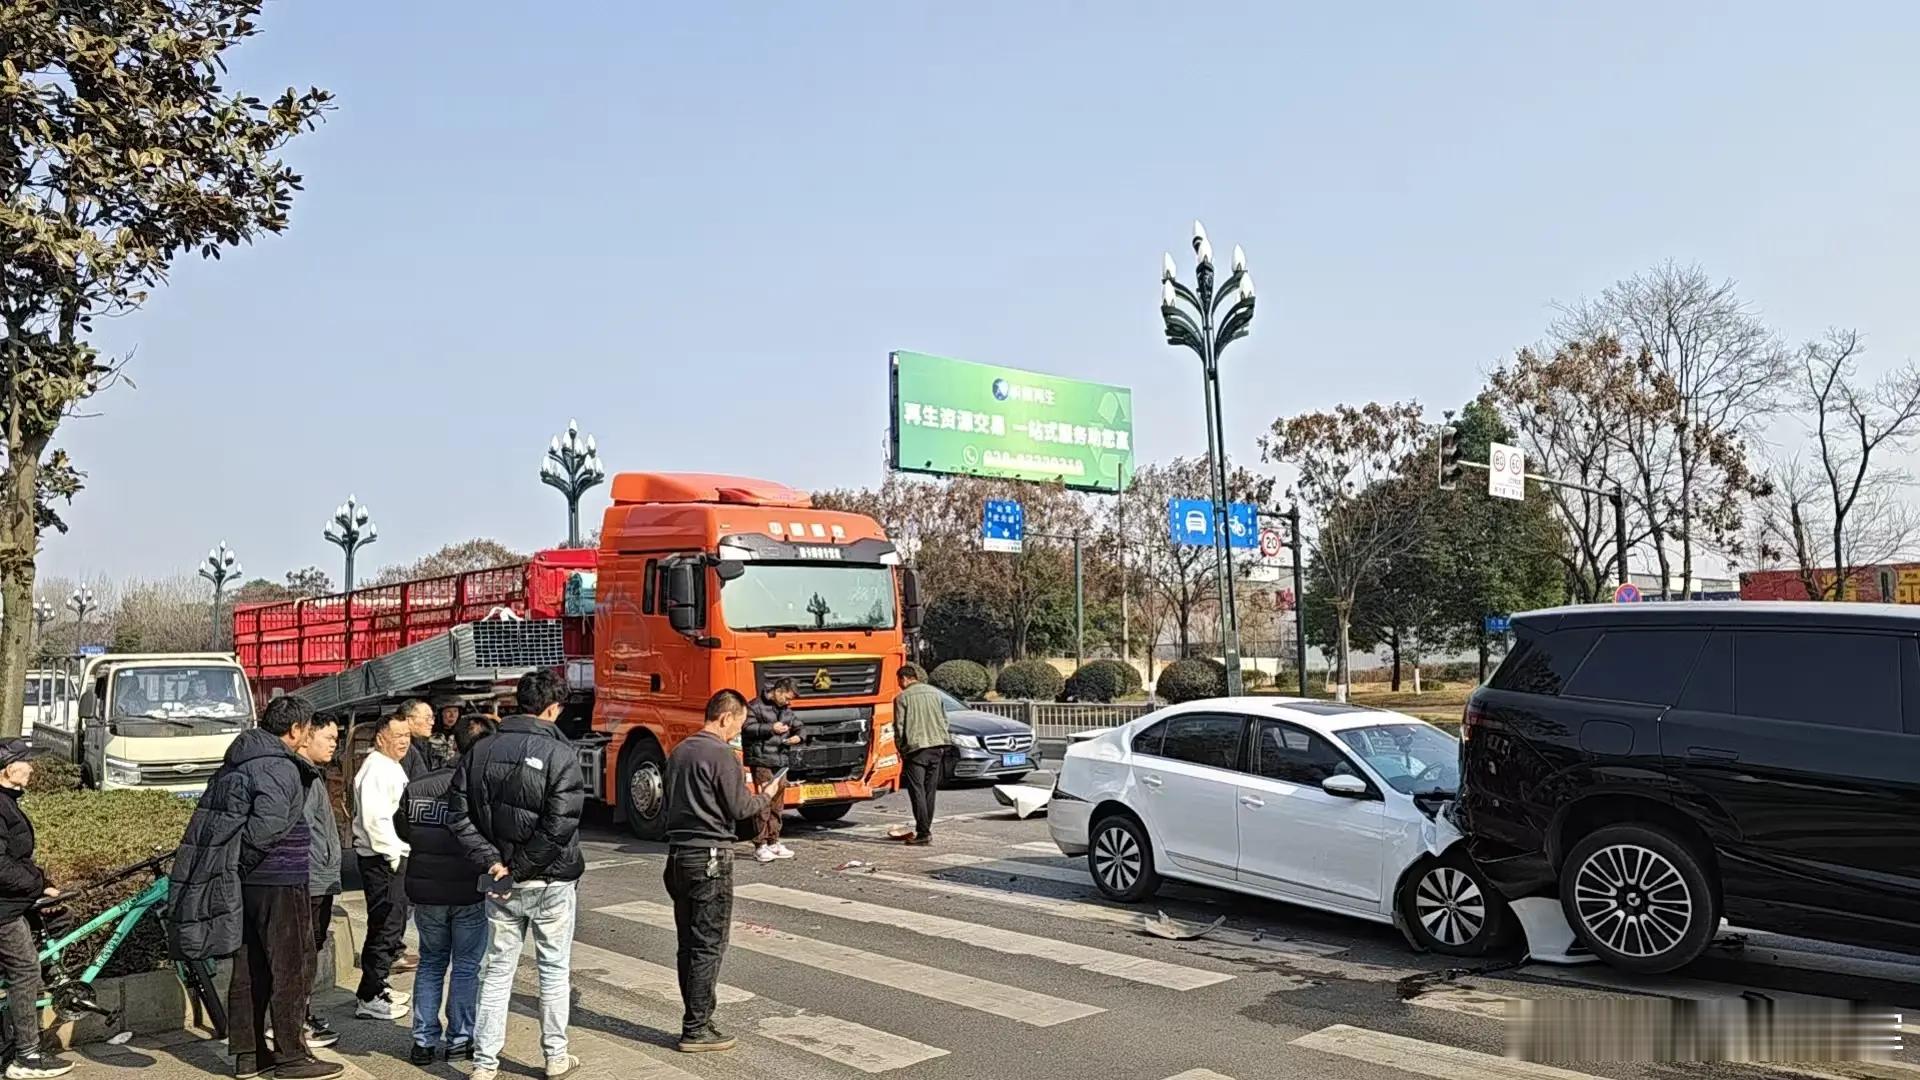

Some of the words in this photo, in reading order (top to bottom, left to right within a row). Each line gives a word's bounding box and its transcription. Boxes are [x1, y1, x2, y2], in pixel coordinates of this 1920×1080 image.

[904, 402, 1005, 436] 再生资源交易
[1266, 536, 1277, 549] 20
